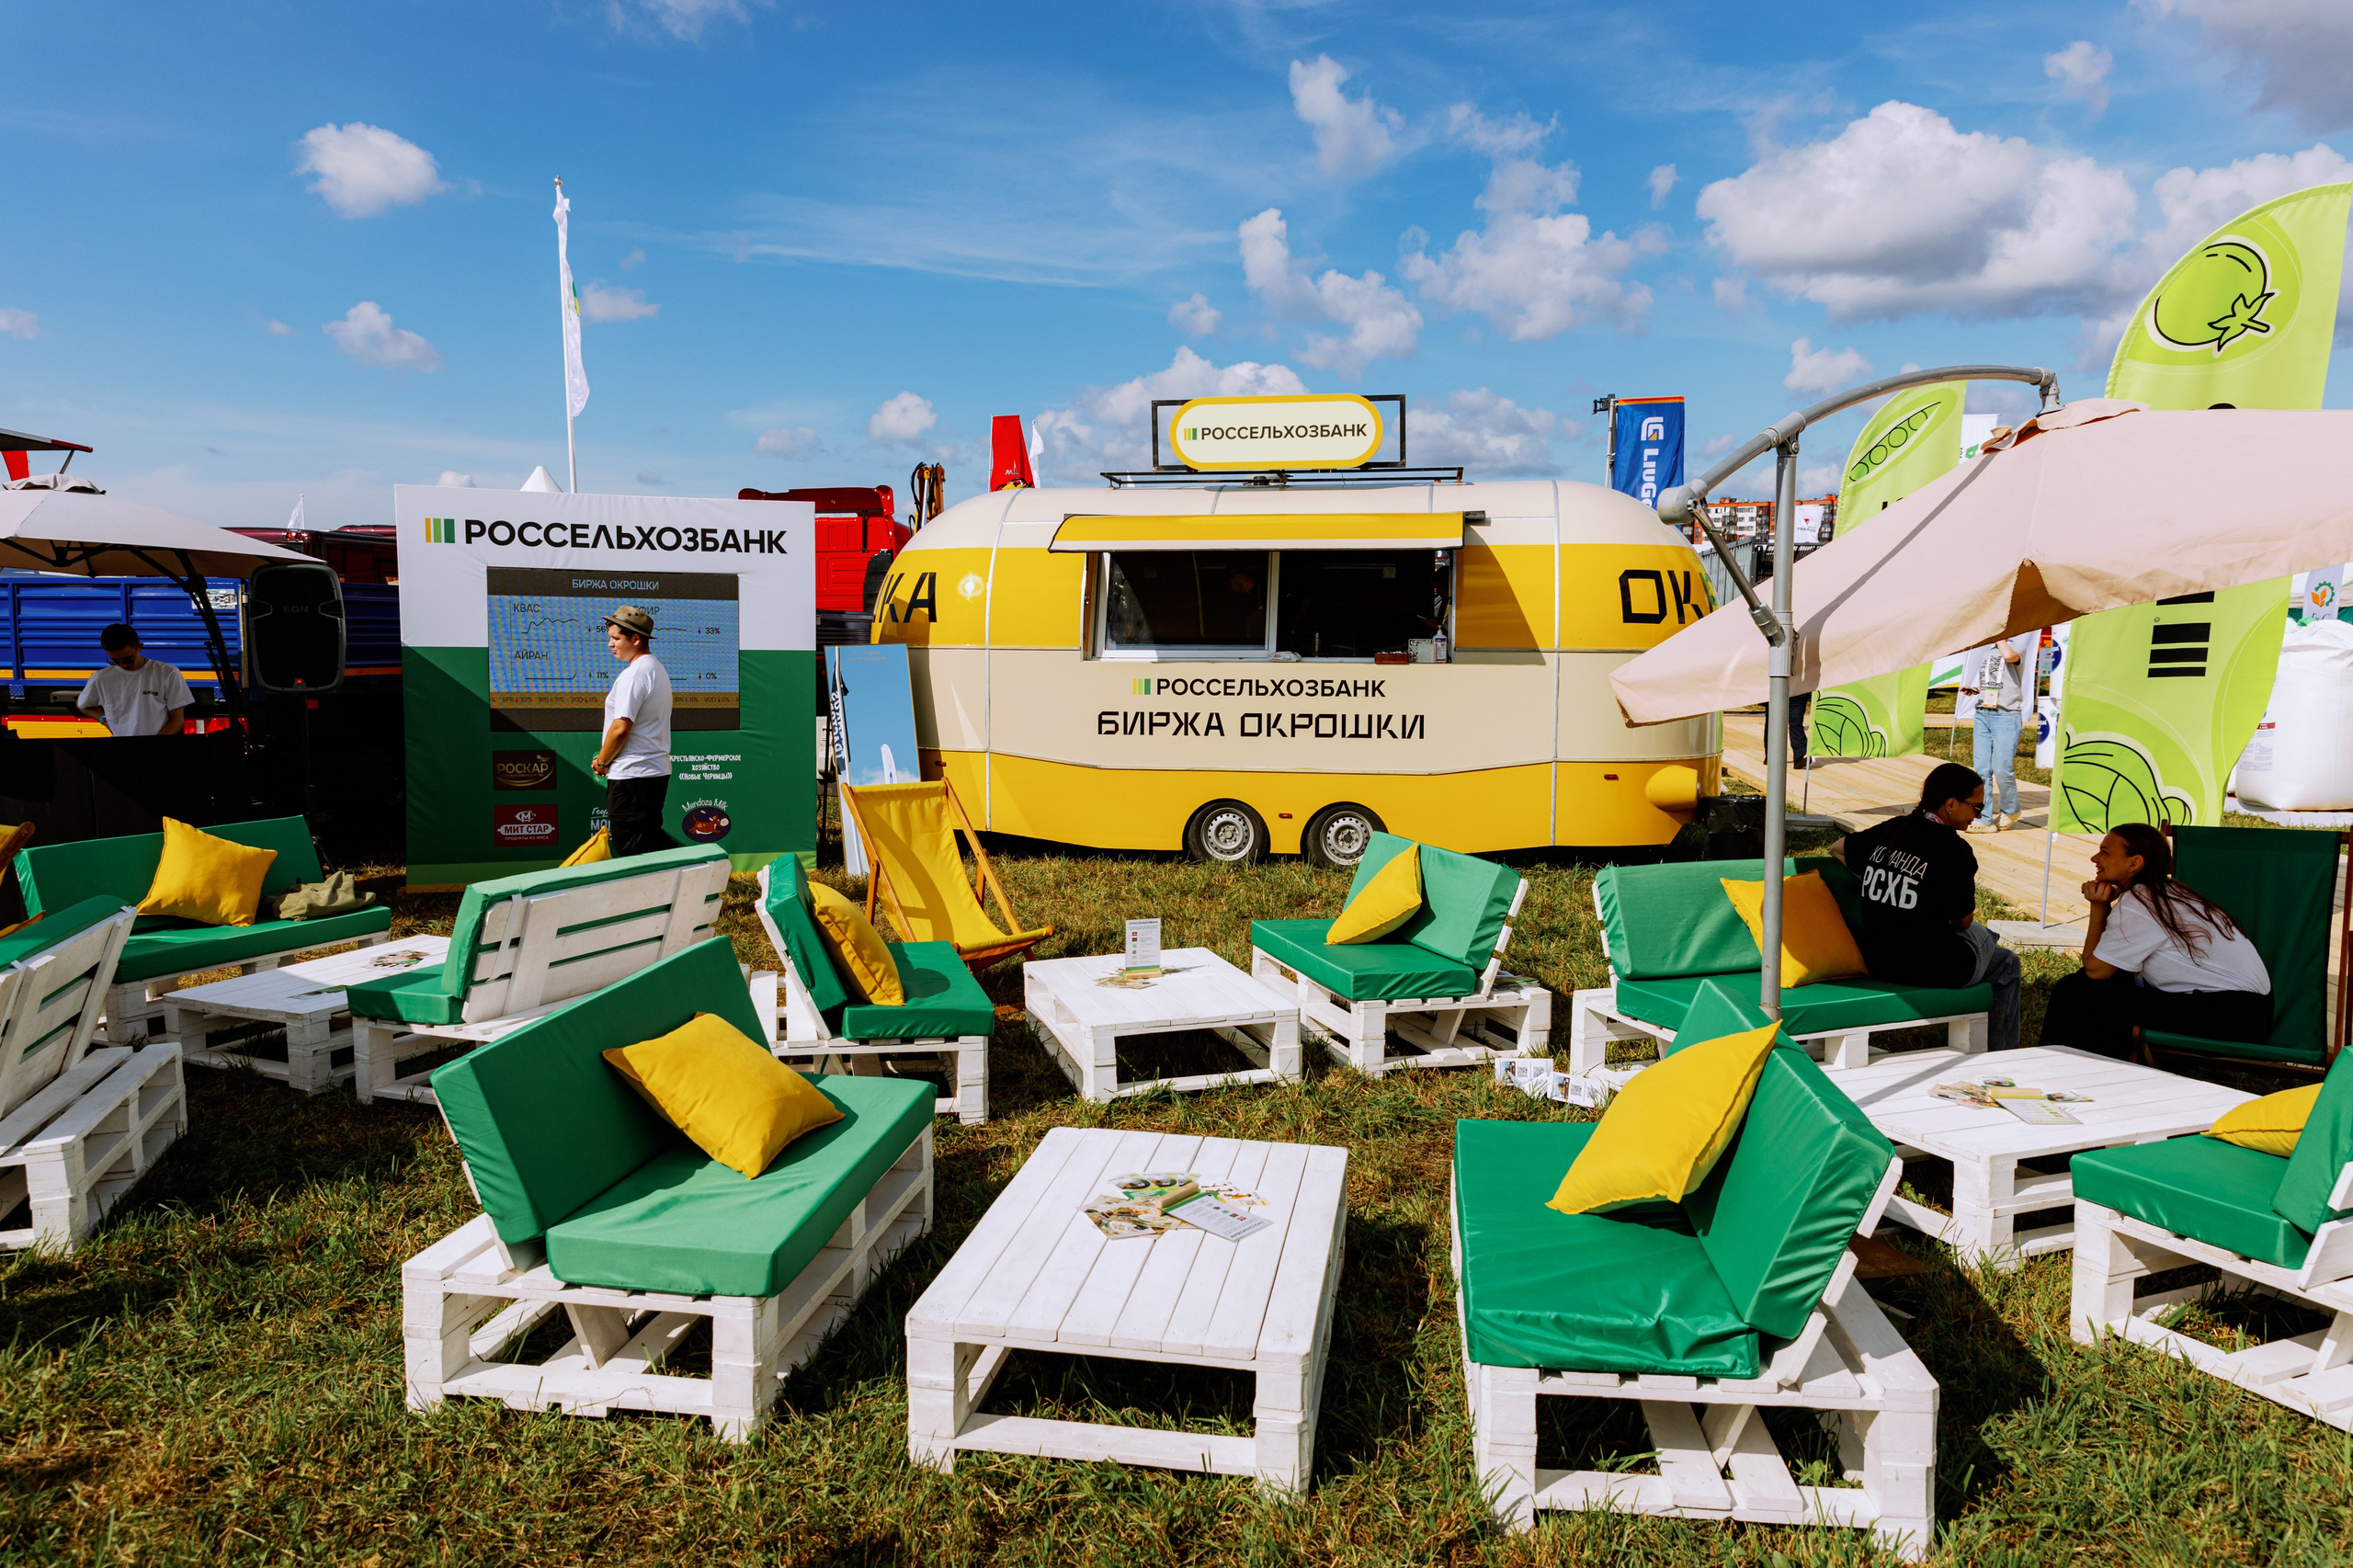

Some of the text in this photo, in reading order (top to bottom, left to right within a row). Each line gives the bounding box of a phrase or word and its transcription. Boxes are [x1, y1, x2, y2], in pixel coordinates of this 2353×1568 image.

[1200, 423, 1368, 440] РОССЕЛЬХОЗБАНК
[464, 518, 789, 554] РОССЕЛЬХОЗБАНК
[572, 578, 660, 590] БИРЖА ОКРОШКИ
[872, 572, 938, 623] КА
[1619, 569, 1715, 624] ОК
[513, 603, 540, 613] КВАС
[596, 625, 608, 633] 56
[705, 627, 721, 635] 33%
[514, 648, 549, 660] АЙРАН
[597, 671, 608, 679] 11%
[705, 672, 717, 680] 0%
[1156, 677, 1386, 698] РОССЕЛЬХОЗБАНК
[1097, 710, 1426, 740] БИРЖА ОКРОШКИ
[497, 763, 549, 774] РОСКАР
[691, 763, 721, 771] ХОЗЯЙСТВО
[681, 797, 729, 812] Mendoza Milk
[504, 824, 549, 835] МИТ СТАР
[1861, 865, 1919, 909] РСХБ
